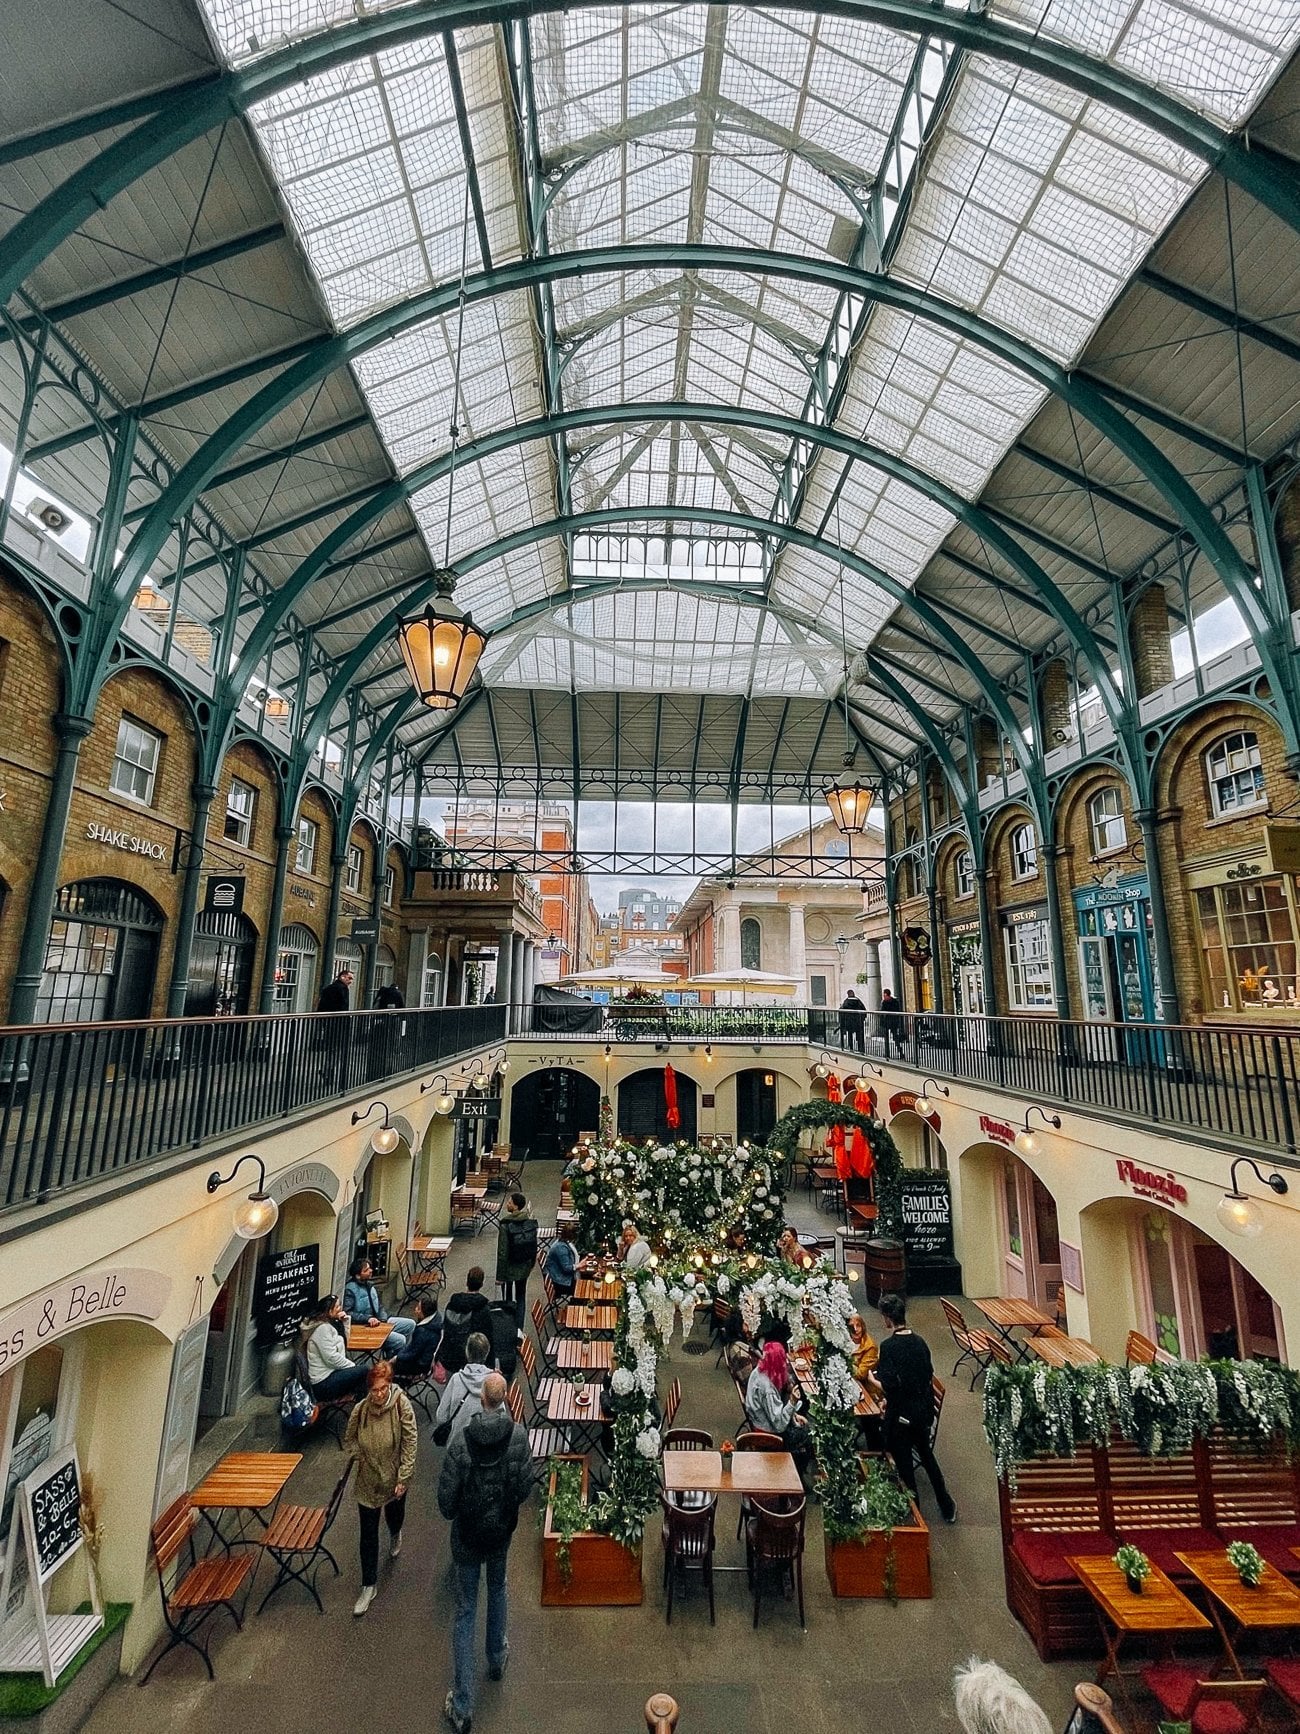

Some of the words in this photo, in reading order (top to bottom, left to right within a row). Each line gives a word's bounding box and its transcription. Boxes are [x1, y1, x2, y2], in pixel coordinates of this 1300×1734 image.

[86, 822, 130, 849] SHAKE
[129, 836, 167, 860] SHACK
[1124, 888, 1141, 898] Shop
[462, 1102, 488, 1115] Exit
[1116, 1159, 1188, 1204] Floozie
[901, 1195, 949, 1212] FAMILIES
[902, 1211, 949, 1223] WELCOME
[266, 1264, 314, 1285] BREAKFAST
[37, 1299, 57, 1337] &
[65, 1275, 126, 1323] Belle
[35, 1475, 66, 1514] SASS
[49, 1485, 79, 1523] BELLE
